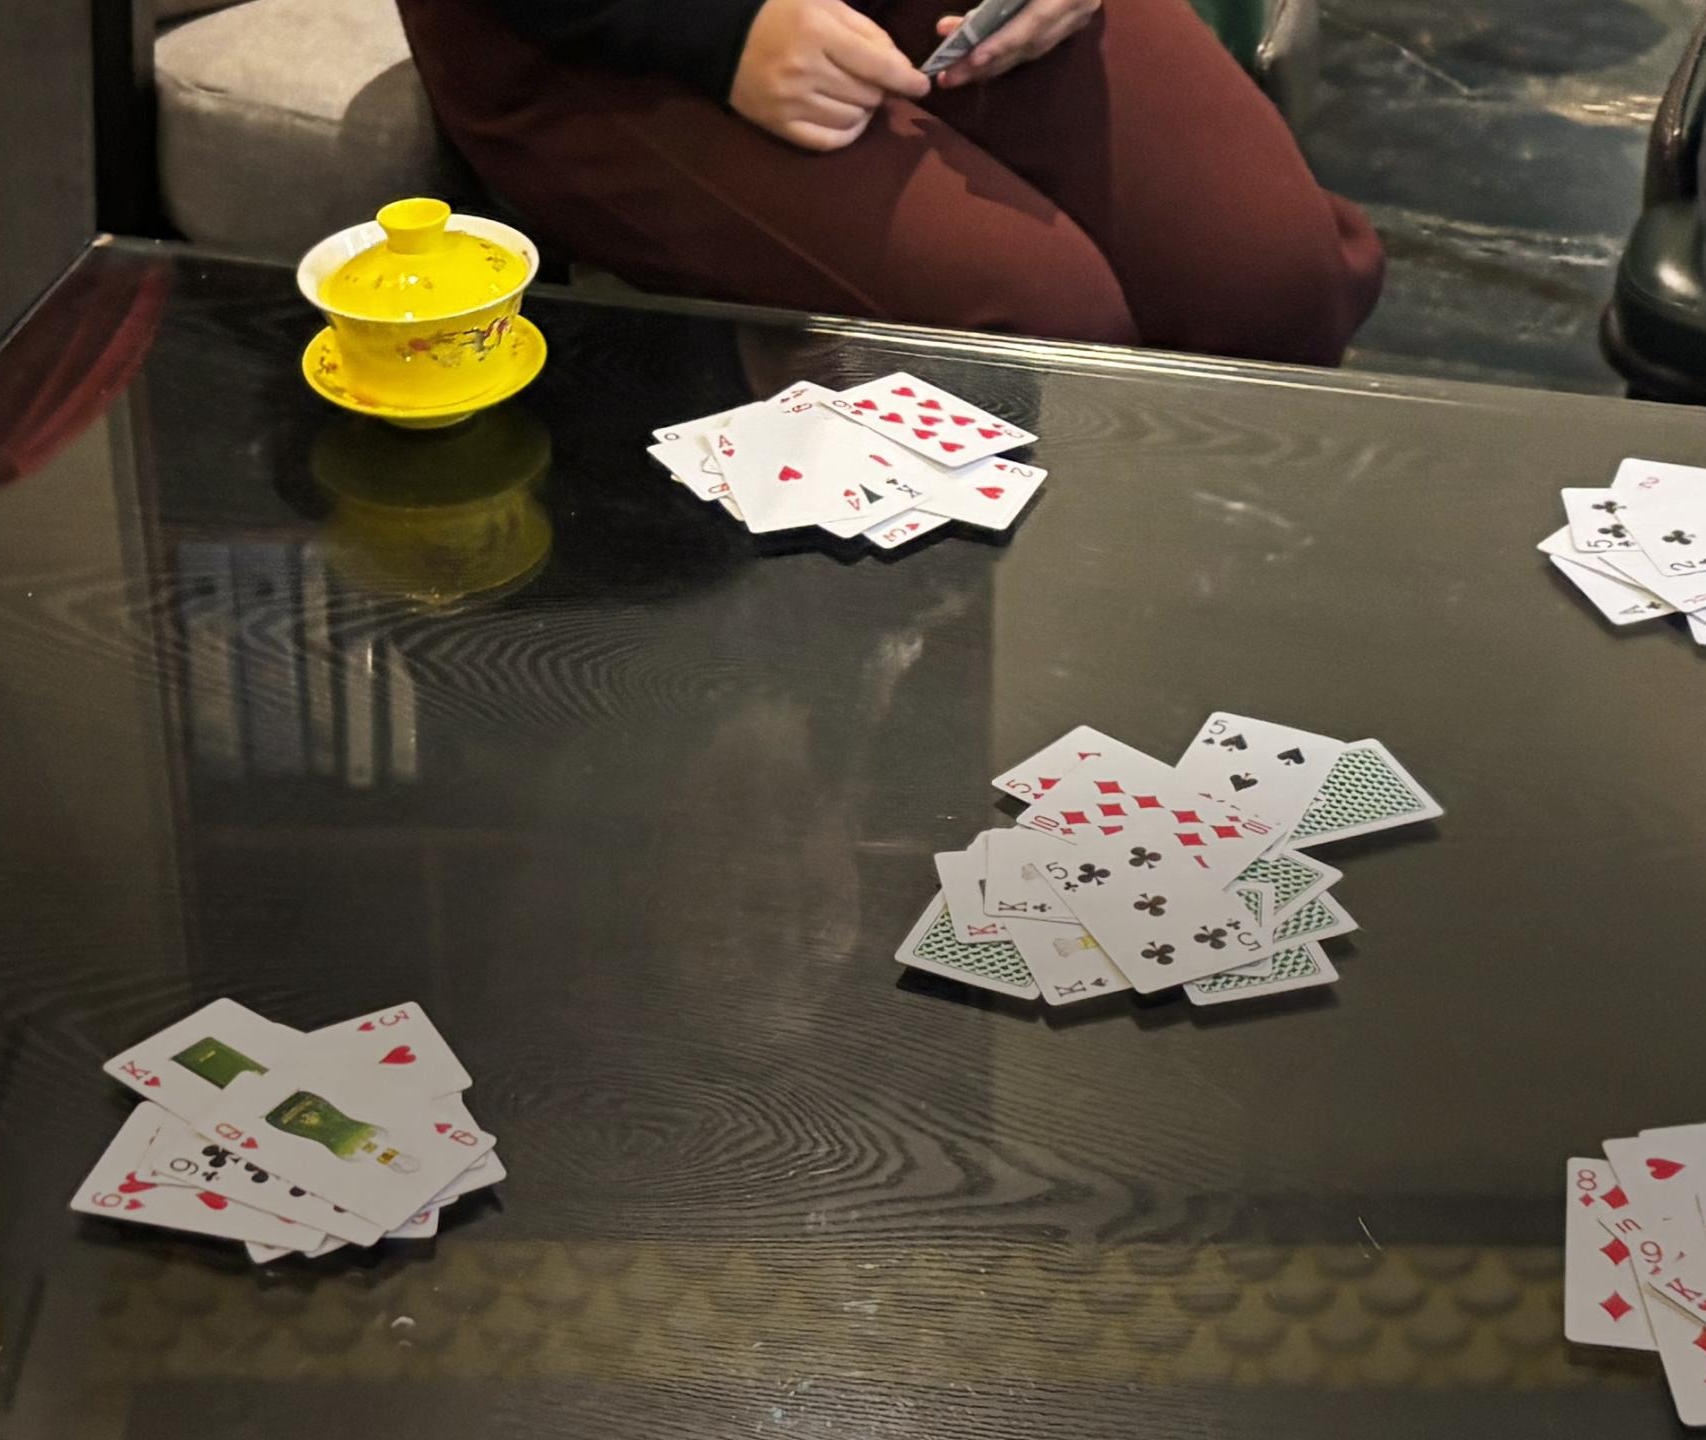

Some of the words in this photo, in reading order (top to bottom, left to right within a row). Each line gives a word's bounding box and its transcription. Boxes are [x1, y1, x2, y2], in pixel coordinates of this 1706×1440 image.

[718, 434, 733, 448] A
[1010, 466, 1034, 478] 2
[1587, 539, 1614, 549] 5
[1670, 560, 1697, 571] 2
[1208, 719, 1229, 736] 5
[1006, 779, 1032, 794] 5
[1030, 815, 1060, 831] 10
[1242, 819, 1273, 835] 10
[1046, 861, 1069, 880] 5
[998, 900, 1028, 913] K
[967, 923, 999, 937] K
[1237, 931, 1262, 952] 5
[1054, 980, 1087, 997] K
[379, 1009, 410, 1027] 3
[120, 1060, 152, 1081] K
[1576, 1169, 1598, 1192] 8
[1639, 1240, 1664, 1264] 9
[1665, 1276, 1704, 1303] K
